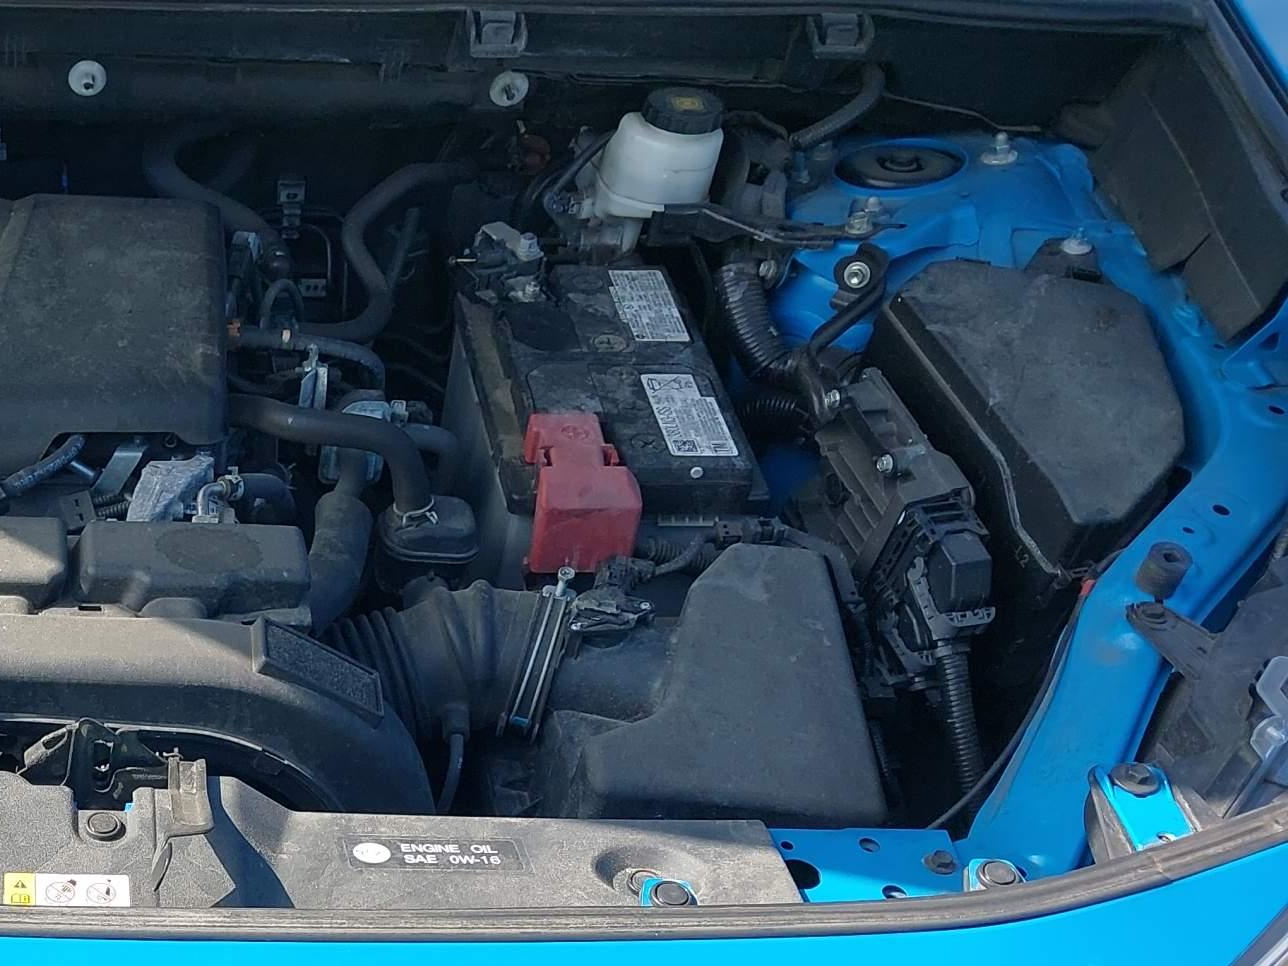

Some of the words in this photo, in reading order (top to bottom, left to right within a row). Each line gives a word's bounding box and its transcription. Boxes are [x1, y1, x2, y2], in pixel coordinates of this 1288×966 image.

[400, 843, 460, 854] ENGINE
[470, 844, 499, 854] OIL
[403, 854, 438, 864] SAE
[449, 855, 501, 865] 0W-16
